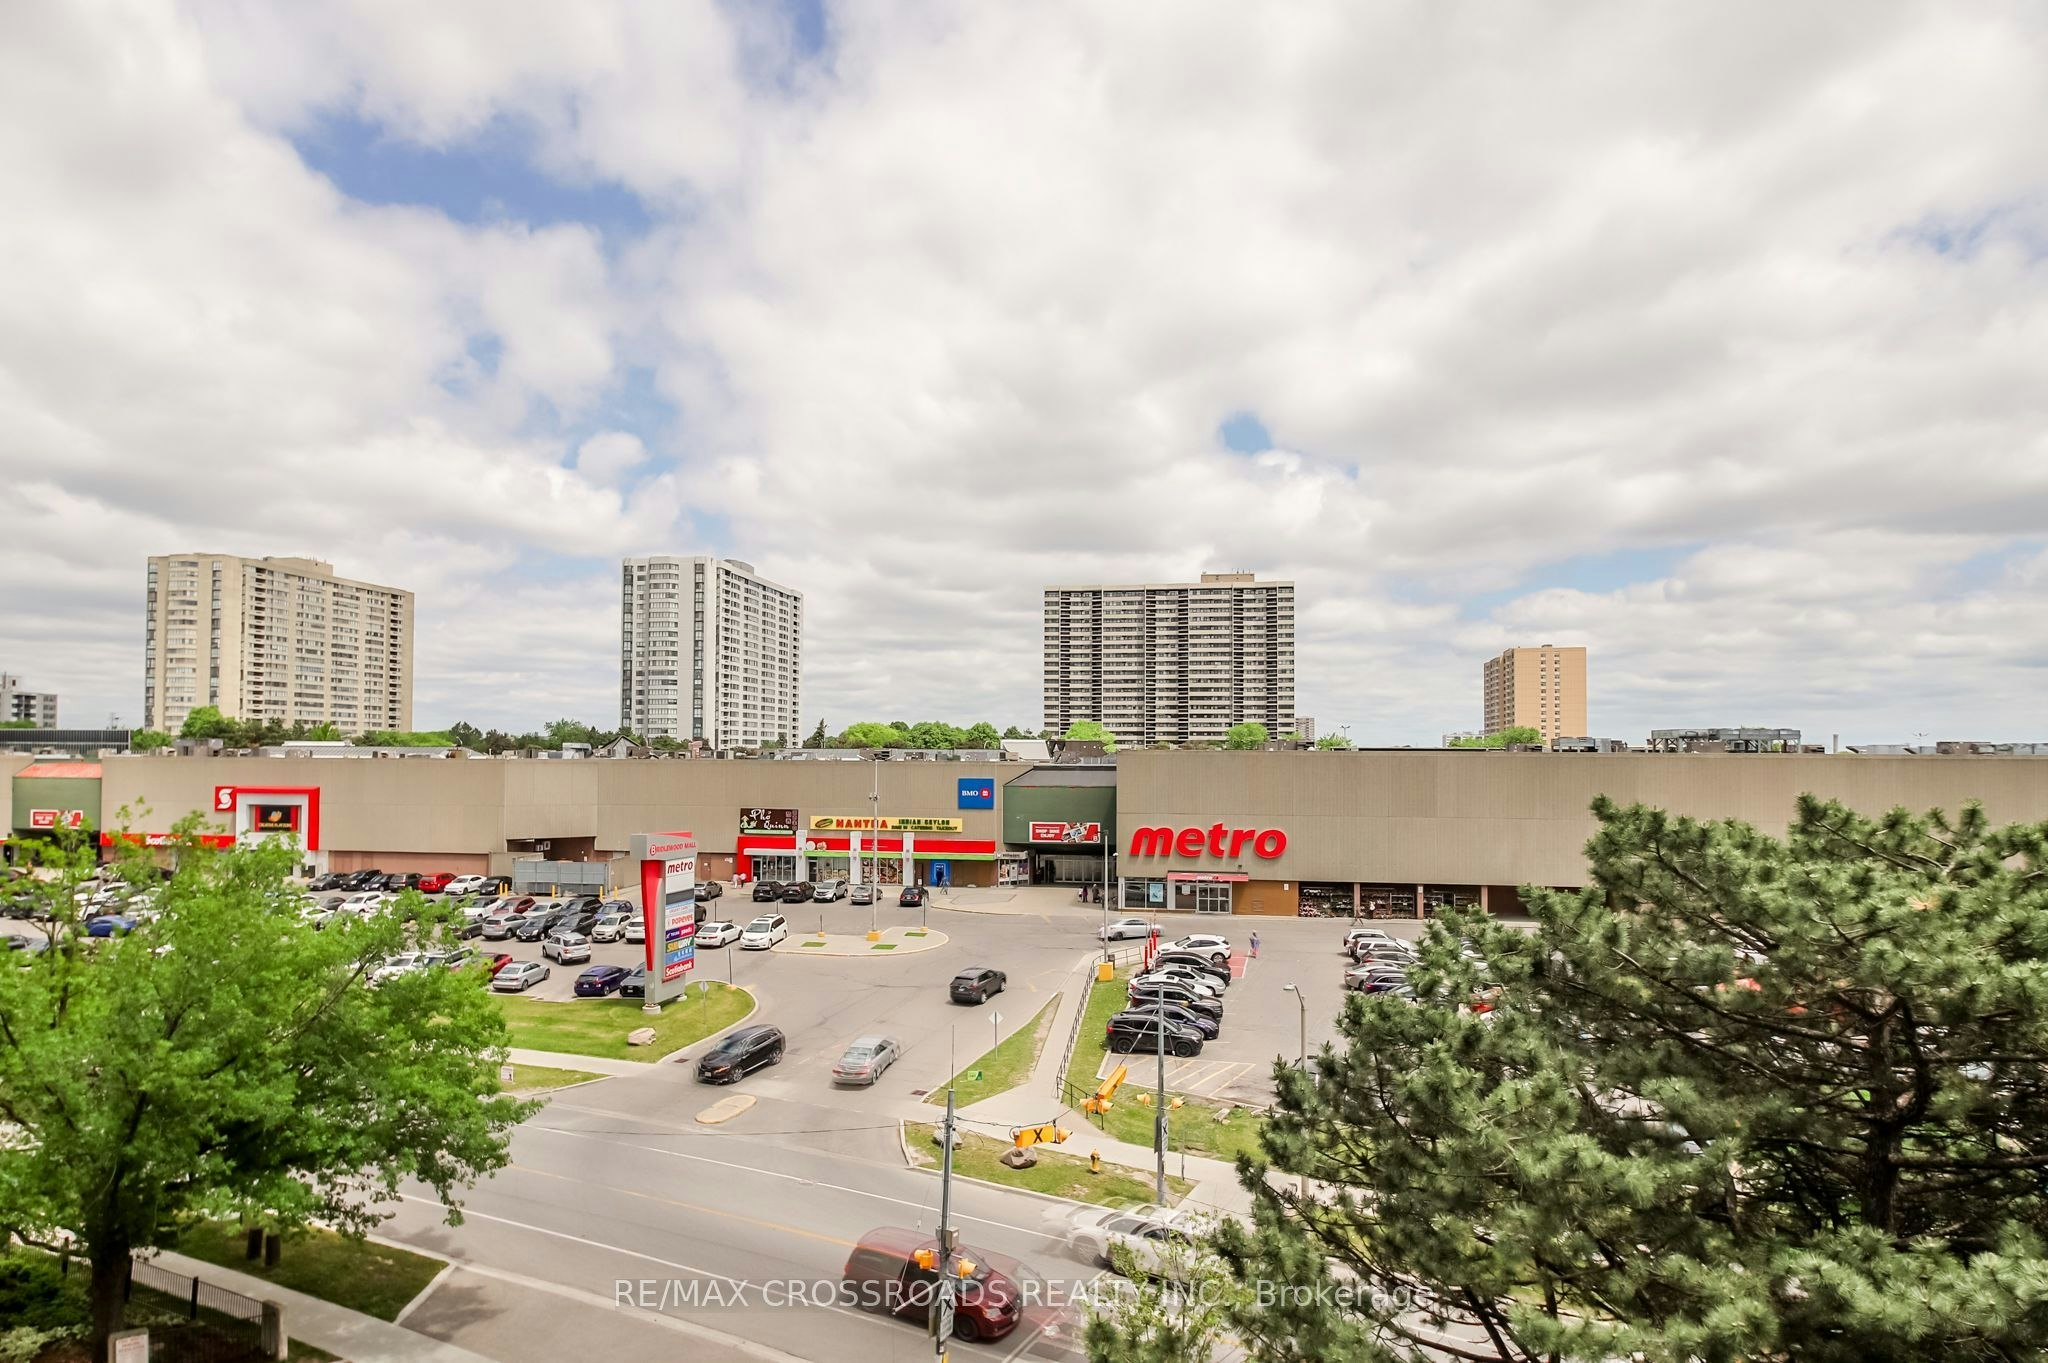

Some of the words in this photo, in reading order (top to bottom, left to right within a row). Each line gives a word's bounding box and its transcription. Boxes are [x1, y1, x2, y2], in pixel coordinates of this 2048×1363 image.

[1129, 823, 1288, 859] metro
[667, 860, 694, 874] metro
[665, 960, 693, 977] Scotiabank
